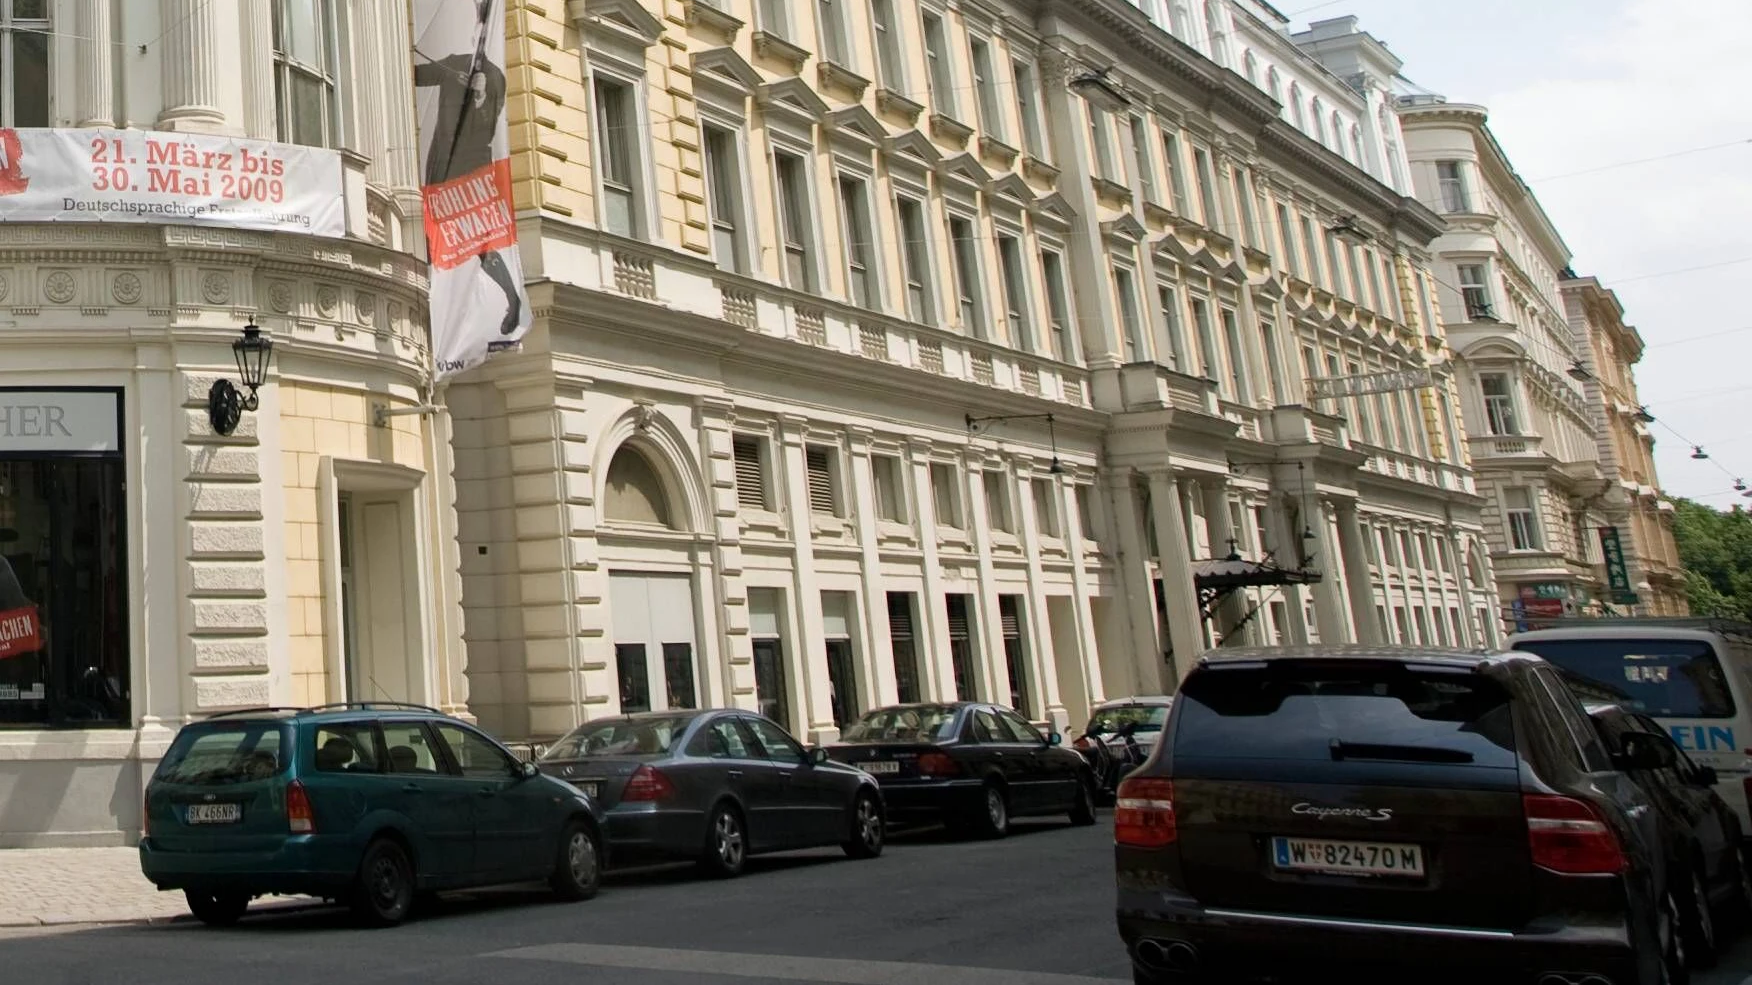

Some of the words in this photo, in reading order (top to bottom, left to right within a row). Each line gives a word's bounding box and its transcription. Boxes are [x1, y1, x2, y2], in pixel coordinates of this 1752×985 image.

[91, 138, 137, 164] 21.
[146, 140, 233, 171] März
[240, 148, 284, 177] bis
[92, 167, 138, 192] 30.
[147, 168, 212, 196] Mai
[220, 174, 284, 204] 2009
[428, 174, 499, 220] FRÜHLING
[63, 197, 205, 219] Deutschsprachige
[436, 359, 465, 372] vbw
[1291, 802, 1371, 820] Cayenne
[1365, 808, 1393, 821] S
[1290, 841, 1306, 863] W
[1324, 844, 1396, 868] 82470
[1400, 848, 1417, 870] M
